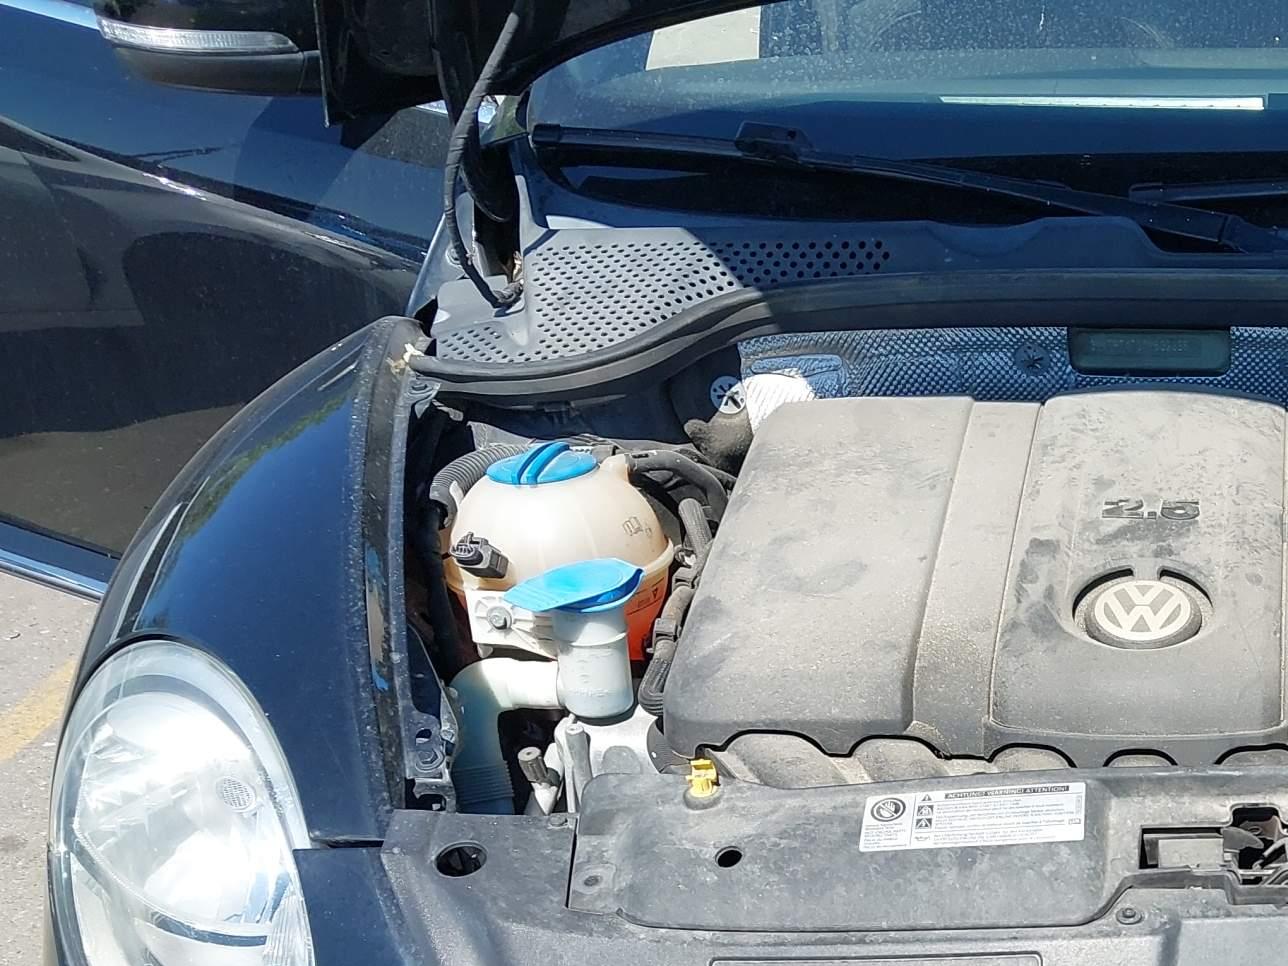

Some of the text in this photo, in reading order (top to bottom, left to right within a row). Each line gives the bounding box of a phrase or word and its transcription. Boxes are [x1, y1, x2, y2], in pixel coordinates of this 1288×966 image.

[1101, 499, 1200, 520] 2.5
[1094, 579, 1191, 641] VW
[1025, 785, 1068, 794] ATTENTION!
